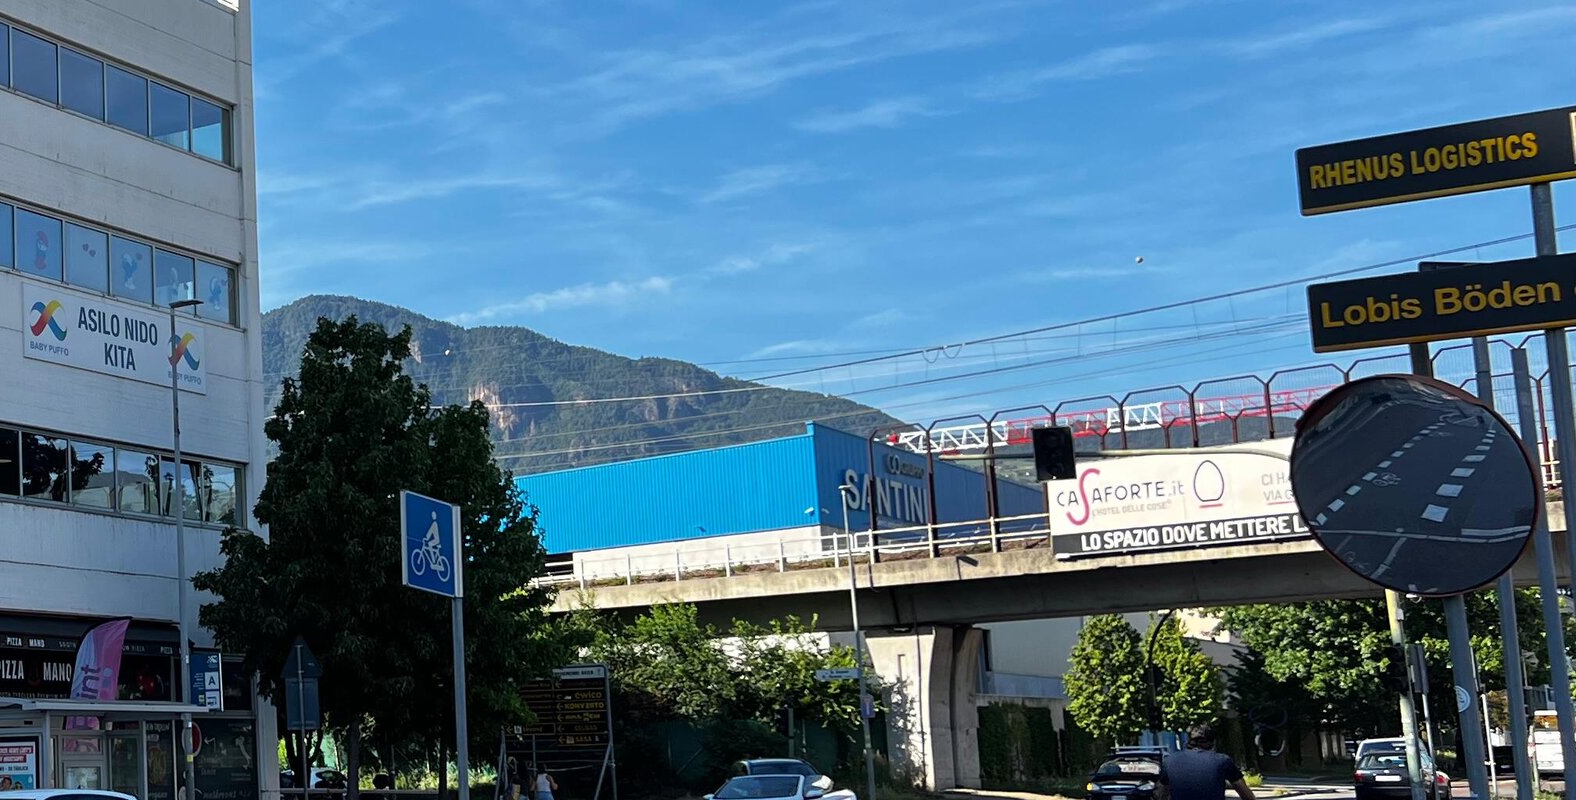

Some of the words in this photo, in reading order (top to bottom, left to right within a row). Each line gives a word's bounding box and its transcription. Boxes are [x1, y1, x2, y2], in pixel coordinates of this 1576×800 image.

[1310, 153, 1405, 190] RHENUS
[1411, 132, 1538, 175] LOGISTICS
[1321, 294, 1423, 328] Lobis
[1434, 281, 1562, 316] Böden
[78, 306, 120, 338] ASILO
[125, 317, 158, 346] NIDO
[30, 340, 48, 352] BABY
[48, 345, 69, 357] PUFFO
[104, 342, 136, 371] KITA
[183, 374, 202, 385] PUFFO
[1261, 473, 1273, 486] CI
[845, 468, 928, 524] SANTINI
[1263, 490, 1283, 501] VIA
[1122, 502, 1144, 513] DELLE
[1081, 533, 1099, 551] LO
[1103, 527, 1160, 549] SPAZIO
[1162, 524, 1208, 544] DOVE
[1210, 516, 1291, 540] METTERE
[6, 636, 22, 646] PIZZA
[43, 662, 72, 682] MANO
[208, 676, 216, 685] A
